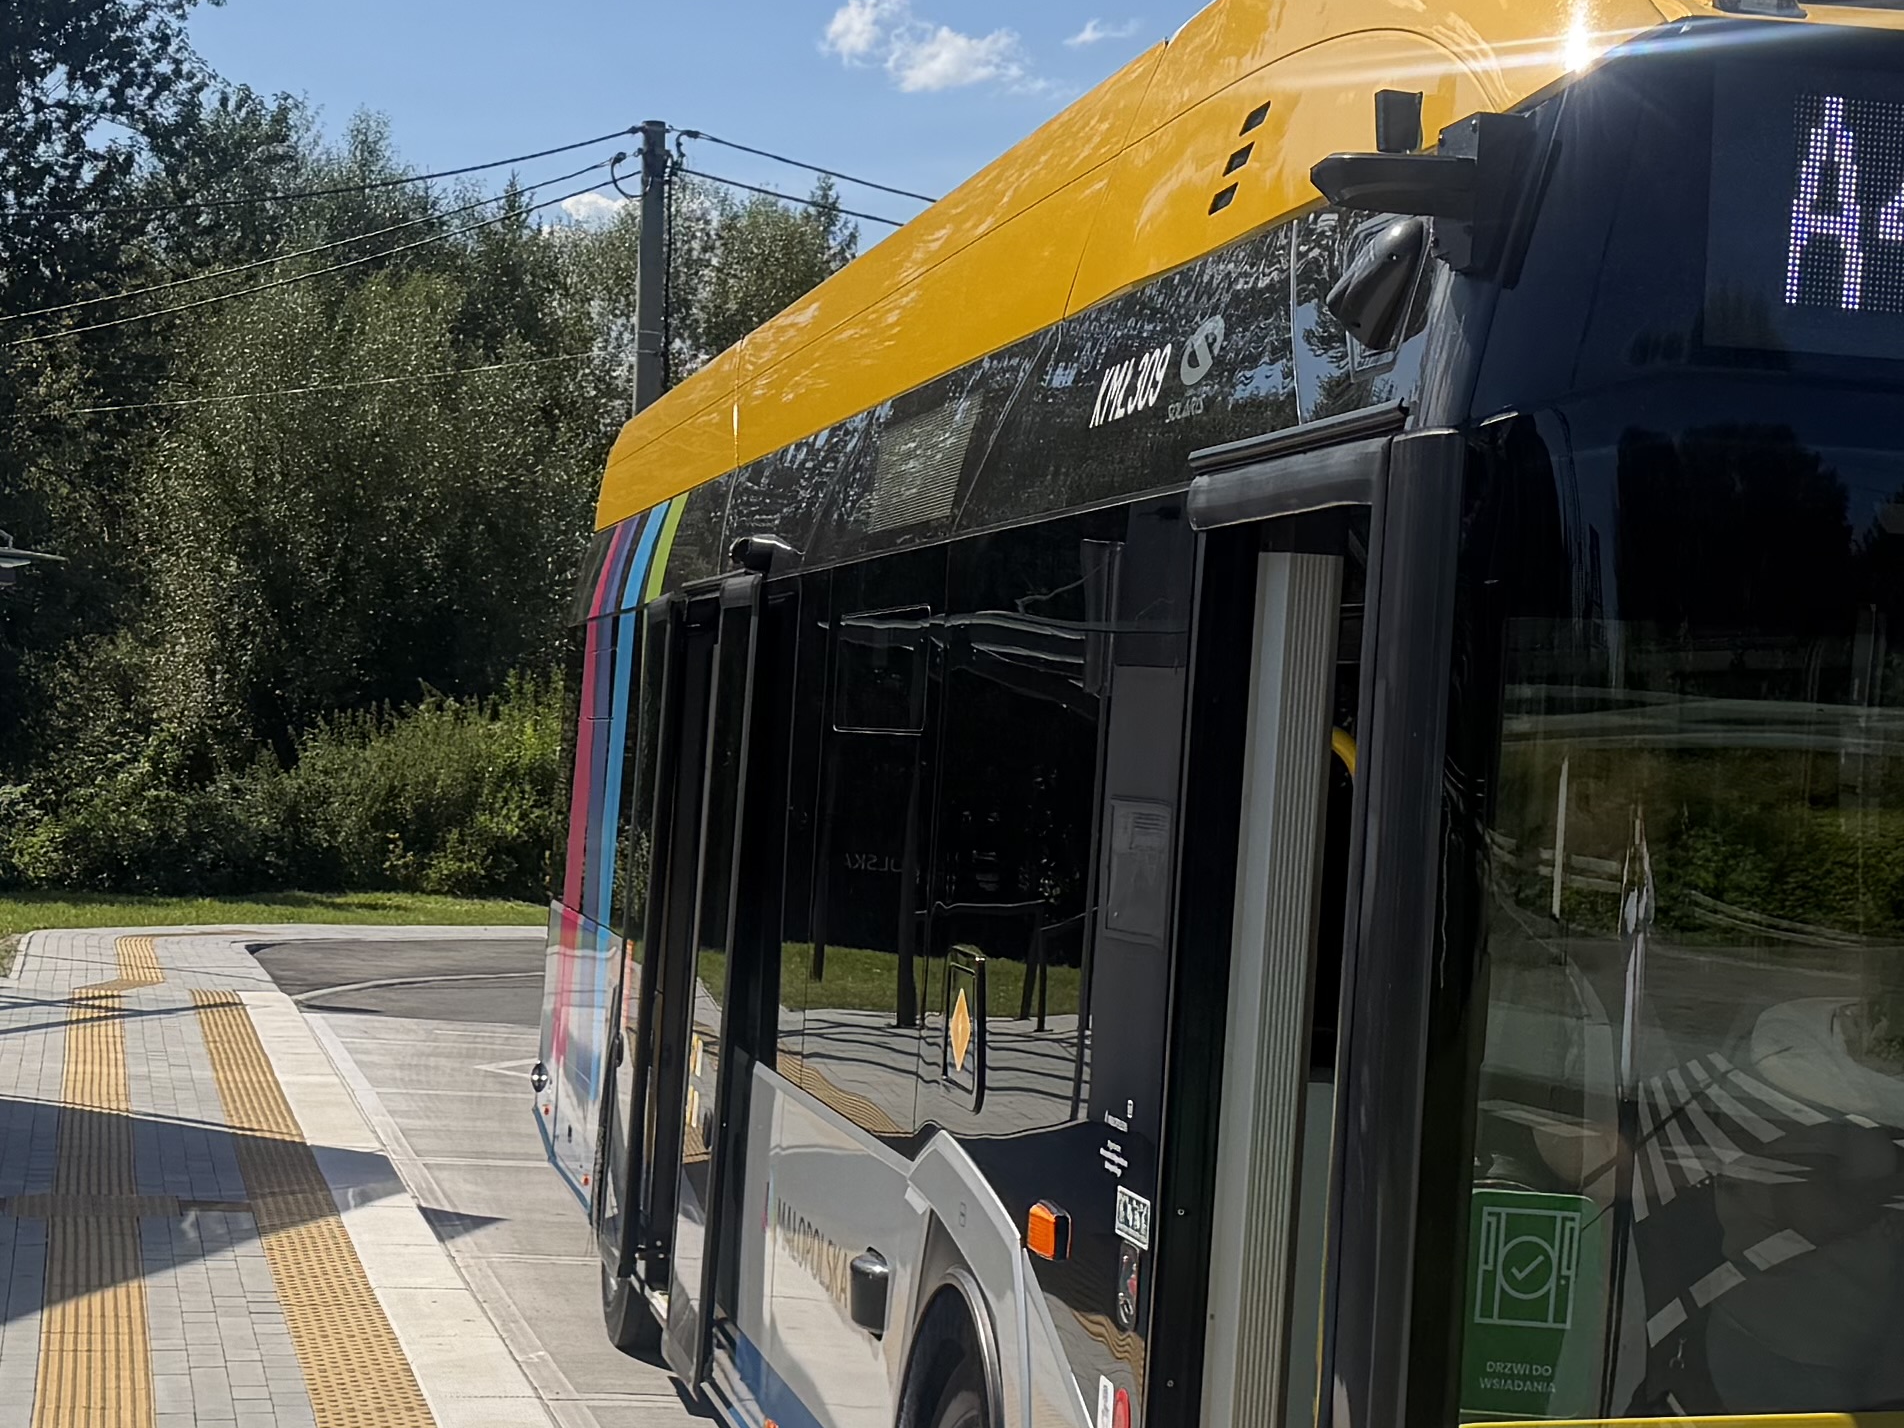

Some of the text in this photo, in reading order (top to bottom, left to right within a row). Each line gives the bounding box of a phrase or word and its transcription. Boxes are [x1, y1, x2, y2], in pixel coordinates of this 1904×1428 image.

[1486, 1361, 1552, 1376] DRZWI DO
[1479, 1377, 1556, 1393] WSIADANIA
